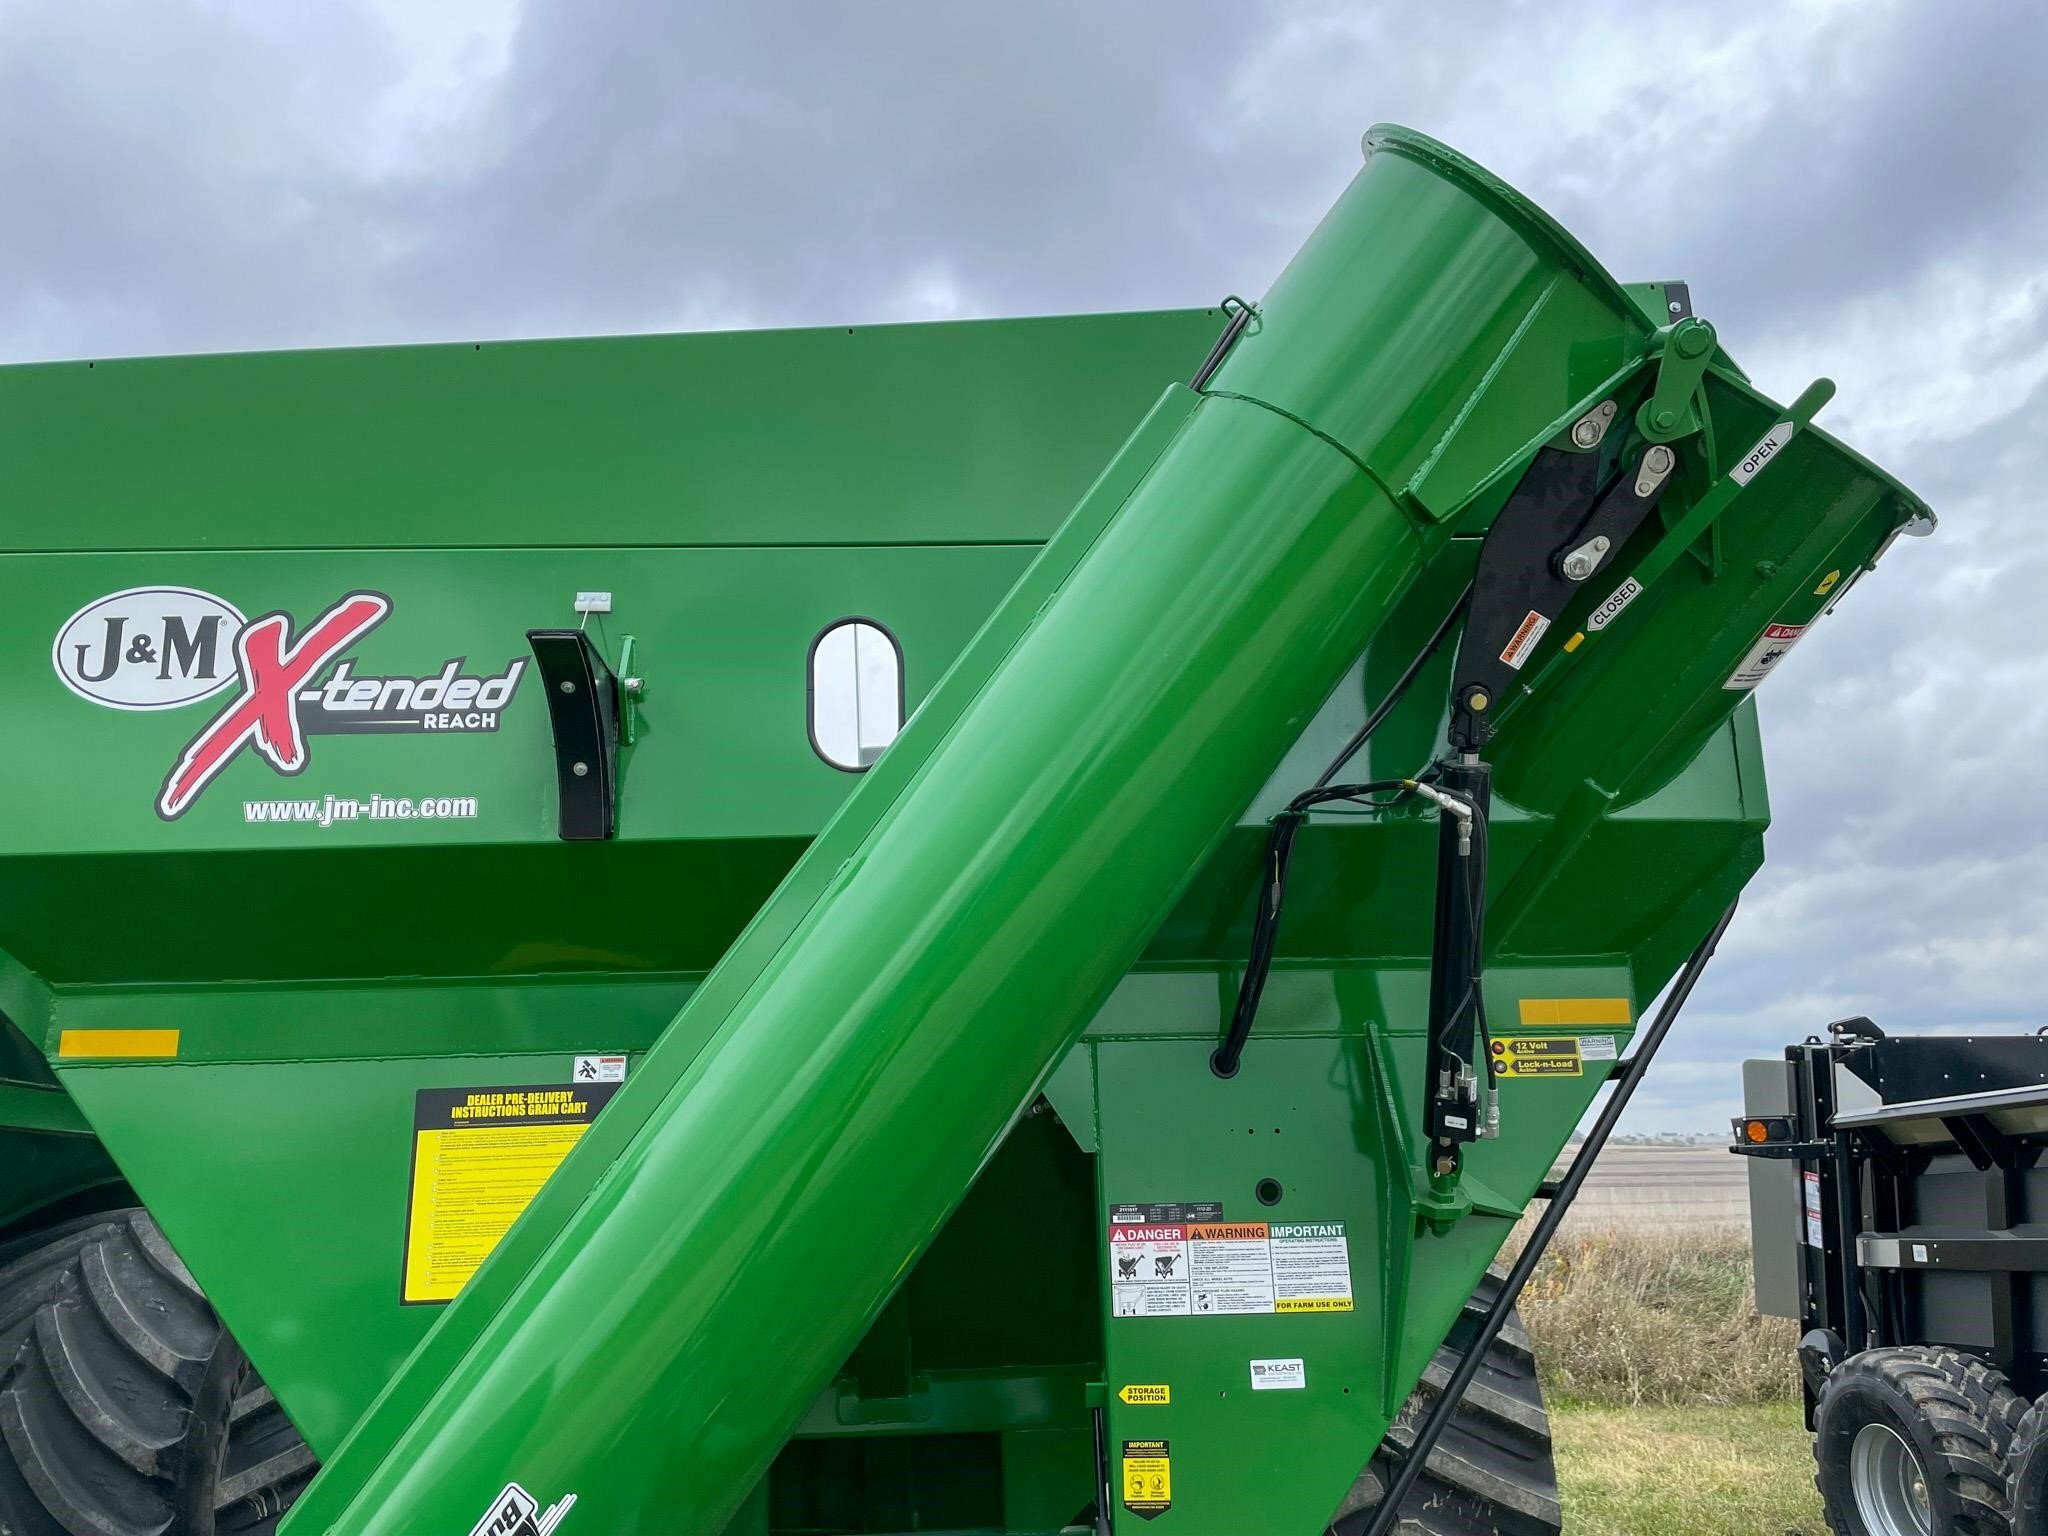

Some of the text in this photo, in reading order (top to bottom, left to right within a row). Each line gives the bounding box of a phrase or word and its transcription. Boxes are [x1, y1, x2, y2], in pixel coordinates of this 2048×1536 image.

[1743, 438, 1778, 473] OPEN
[1594, 582, 1637, 625] CLOSED
[1511, 617, 1536, 652] WARNING
[424, 712, 496, 729] REACH
[244, 794, 478, 828] www.jm-inc.com
[1516, 1042, 1548, 1050] 12 Volt
[1519, 1060, 1573, 1068] Lock-n-Load
[467, 1091, 573, 1107] DEALER PRE-DELIVERY
[451, 1102, 588, 1119] INSTRUCTIONS GRAIN CART
[1127, 1229, 1181, 1241] DANGER
[1205, 1227, 1265, 1239] WARNING
[1271, 1225, 1343, 1237] IMPORTANT
